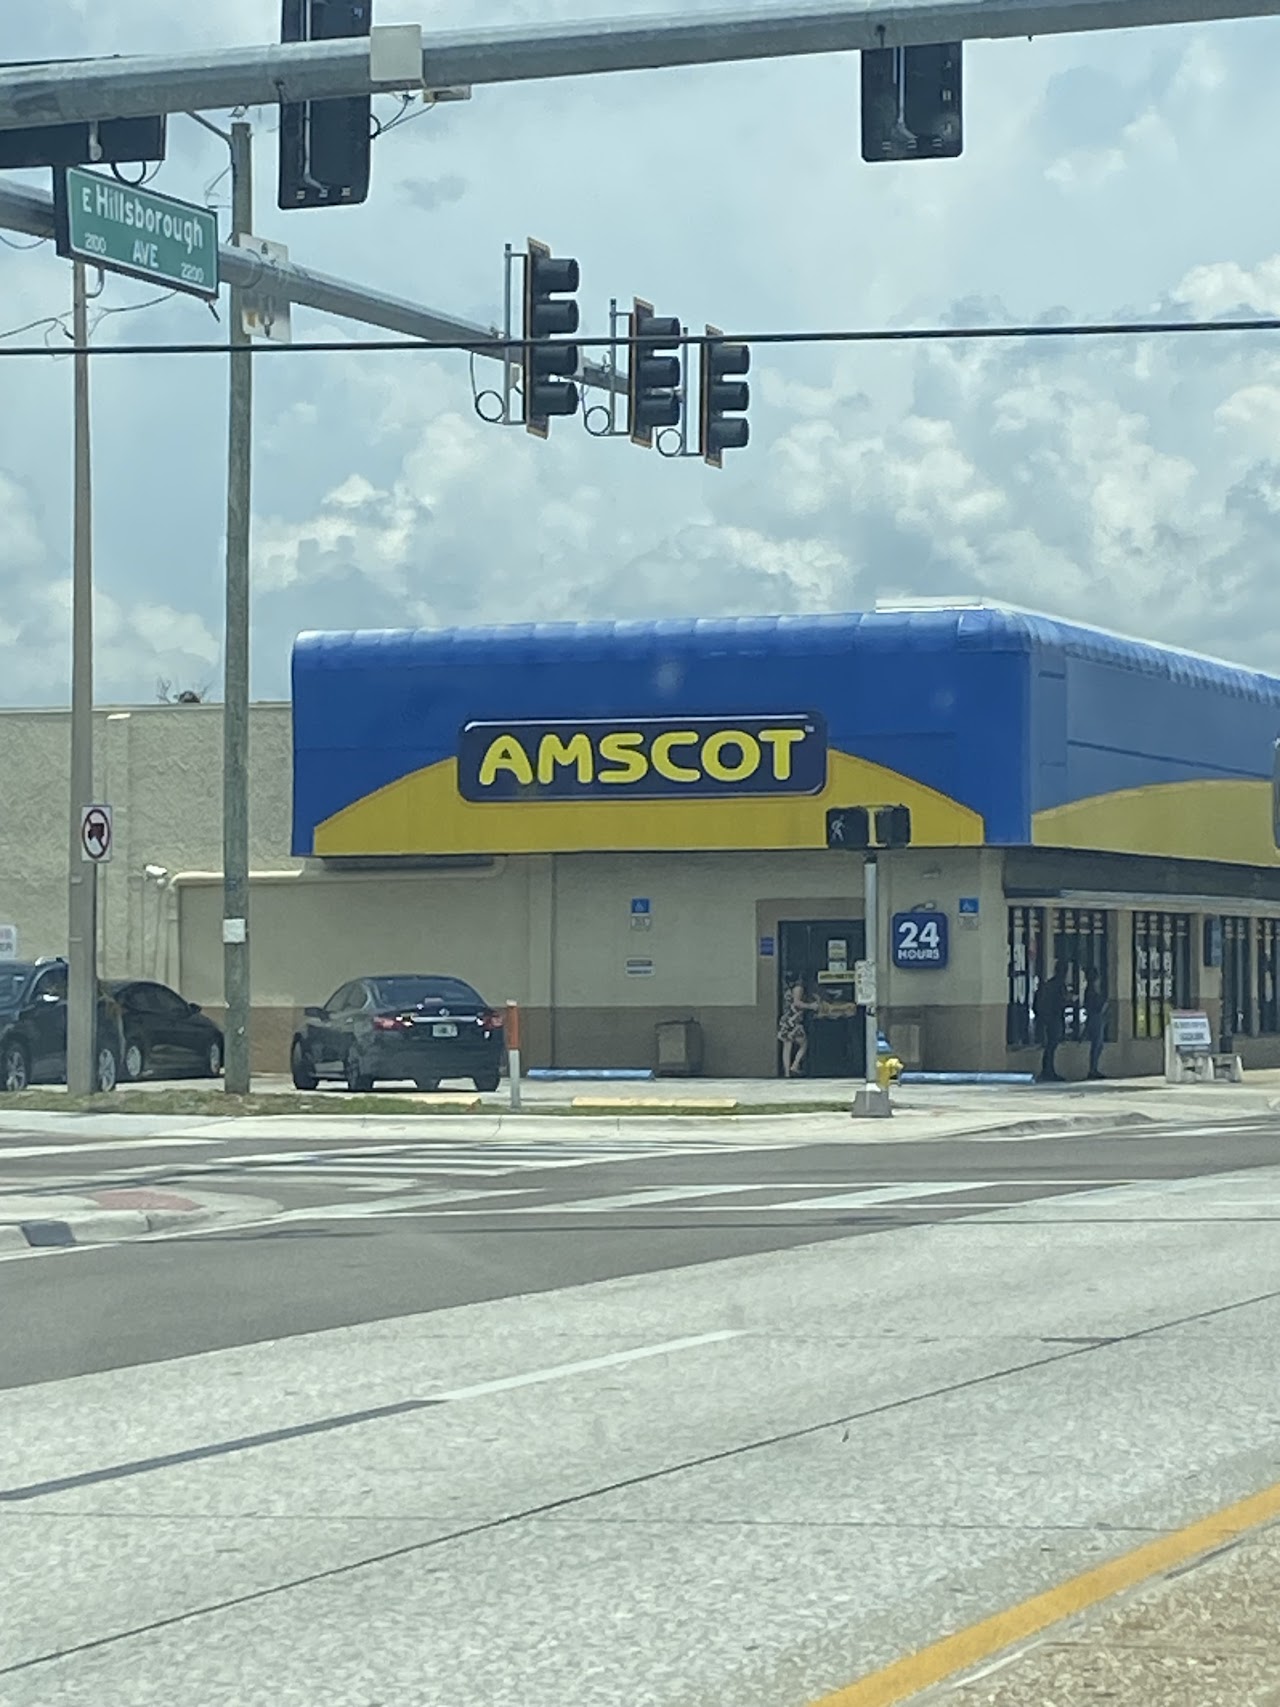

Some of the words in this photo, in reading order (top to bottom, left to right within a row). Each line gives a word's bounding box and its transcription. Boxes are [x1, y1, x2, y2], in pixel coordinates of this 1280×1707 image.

[82, 187, 92, 213] E
[96, 184, 203, 254] Hillsborough
[132, 239, 160, 269] AVE
[479, 729, 806, 785] AMSCOT
[898, 921, 940, 948] 24
[897, 948, 940, 960] HOURS
